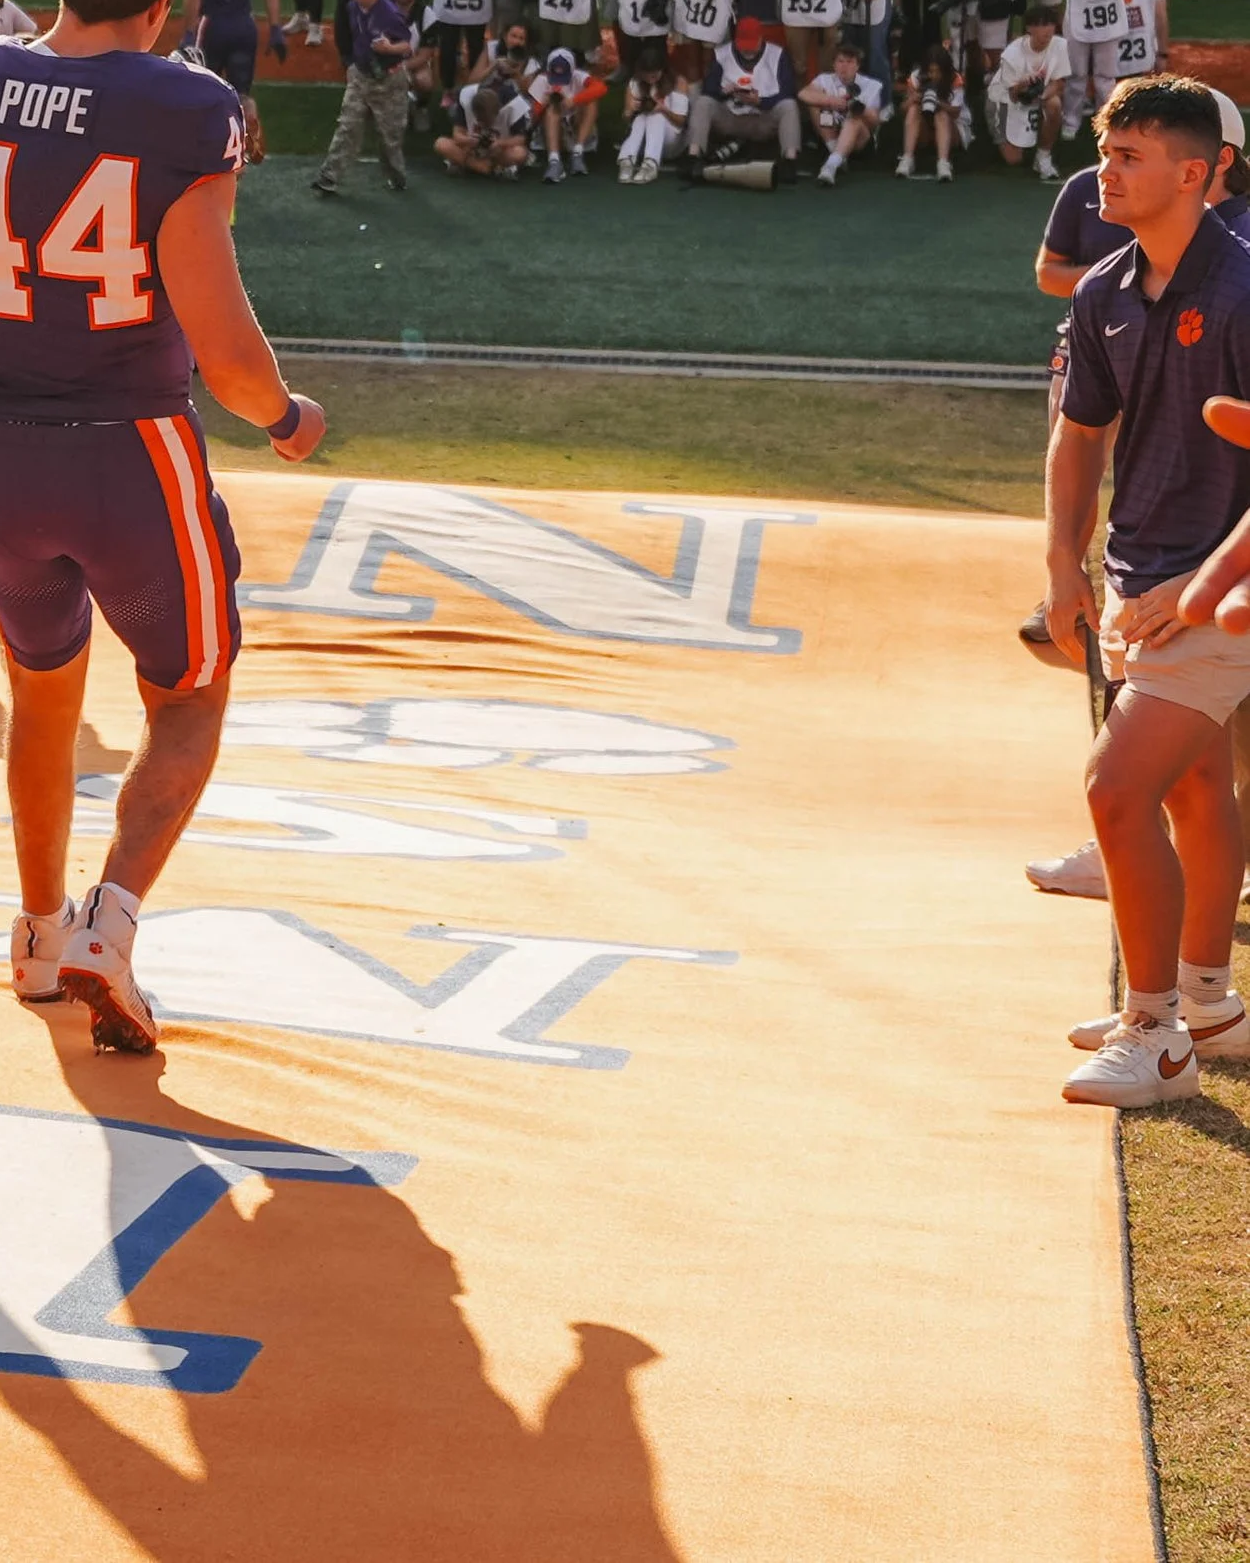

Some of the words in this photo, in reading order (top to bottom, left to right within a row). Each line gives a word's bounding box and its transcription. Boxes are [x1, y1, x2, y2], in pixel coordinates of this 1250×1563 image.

[1083, 3, 1118, 30] 198
[1118, 38, 1147, 62] 23
[223, 115, 250, 173] 4
